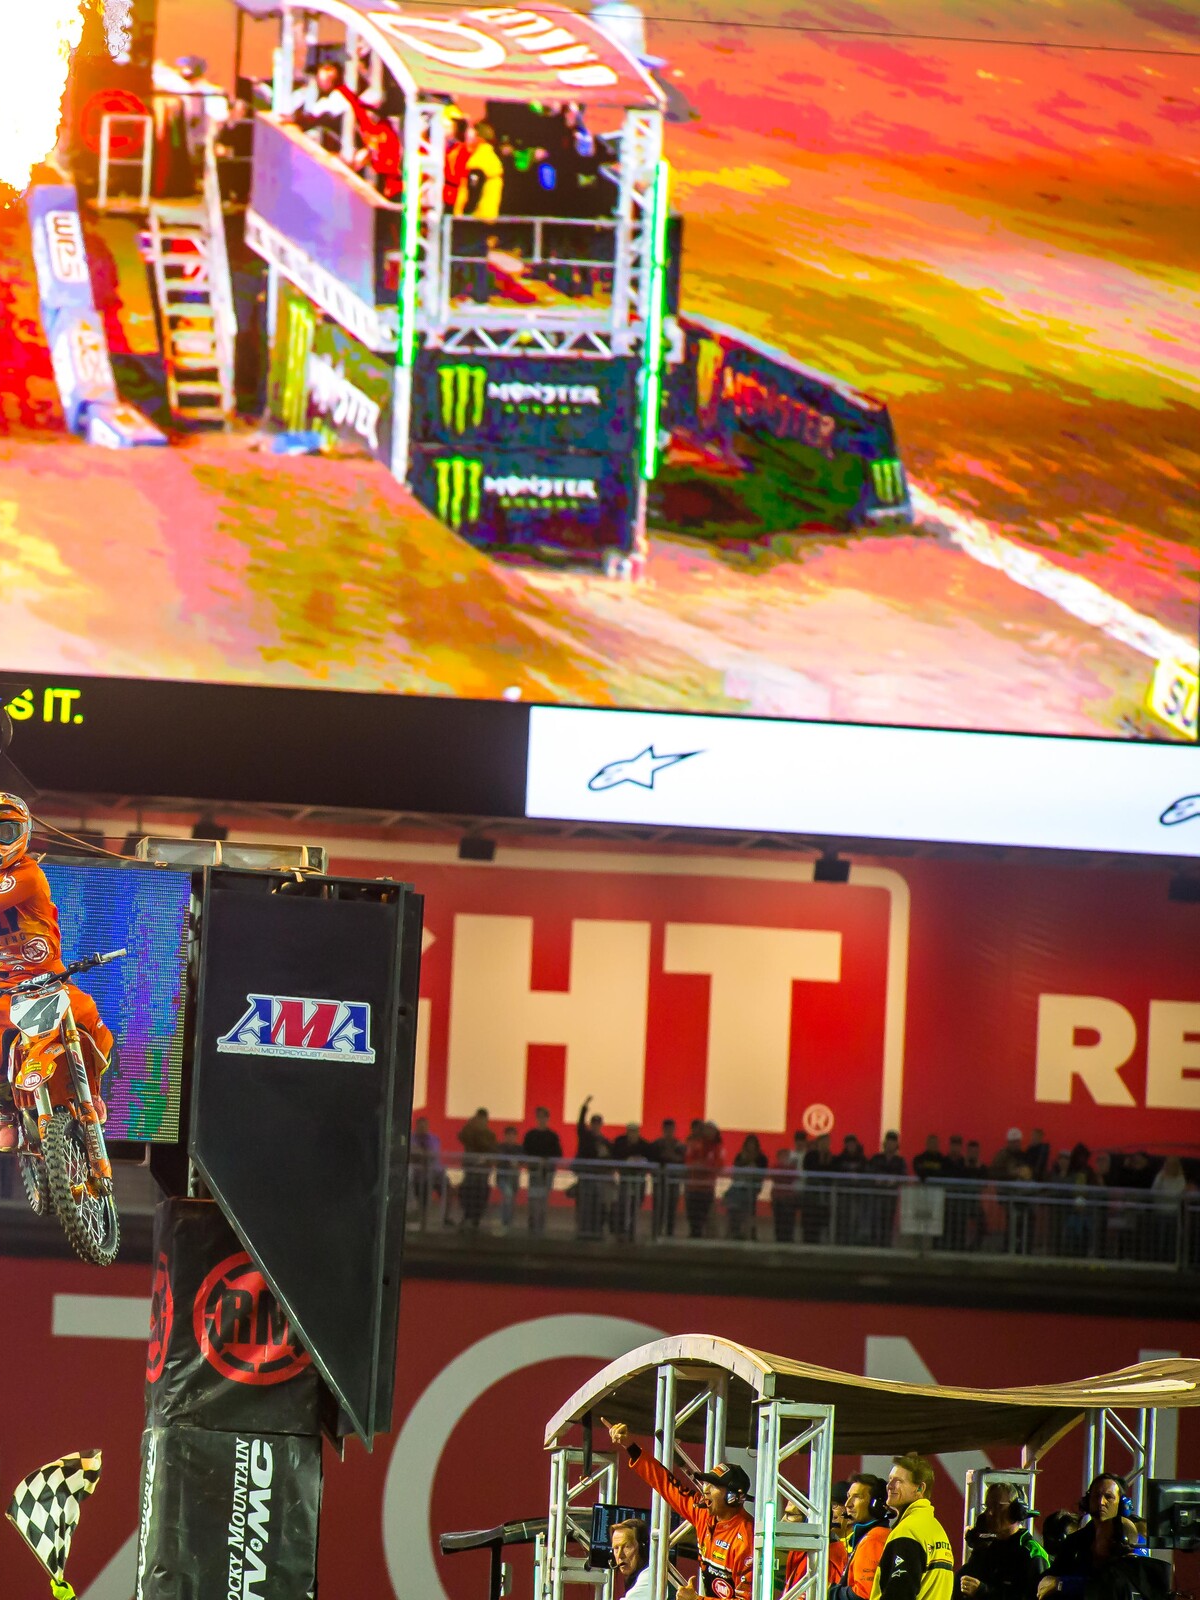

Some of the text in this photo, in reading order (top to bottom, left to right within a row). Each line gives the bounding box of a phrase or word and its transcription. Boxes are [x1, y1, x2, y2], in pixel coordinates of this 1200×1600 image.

[43, 687, 84, 725] IT.
[17, 993, 61, 1034] 4
[218, 997, 374, 1055] AMA
[421, 912, 842, 1133] HT
[218, 1044, 374, 1062] AMERICAN MOTORCYCLIST ASSOCIATION
[227, 1437, 250, 1551] MOUNTAIN
